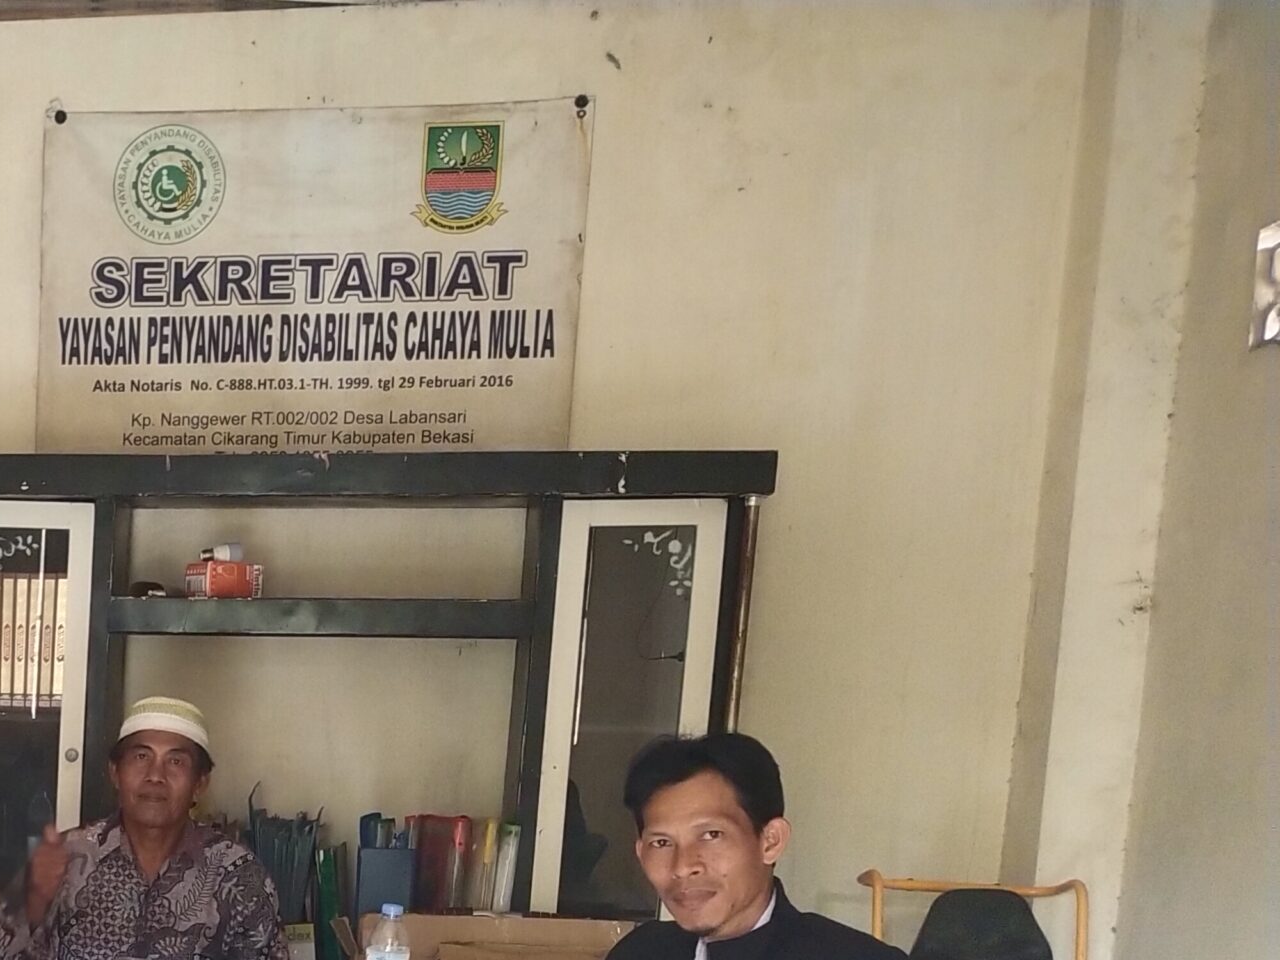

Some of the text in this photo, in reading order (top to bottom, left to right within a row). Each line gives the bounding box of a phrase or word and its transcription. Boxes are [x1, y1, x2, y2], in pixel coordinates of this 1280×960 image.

[117, 128, 222, 207] YAYASAN PENYANDANG DISABILITAS
[128, 212, 210, 240] CAHAYA MULIA
[89, 249, 528, 308] SEKRETARIAT
[58, 308, 555, 366] YAYASAN PENYANDANG DISABILITAS CAHAYA MULIA
[92, 374, 514, 393] Akta Notaris No. C-888.HT.03.1-TH. 1999. tgl 29 Februari 2016
[131, 409, 467, 430] Kp. Nanggewer RT.002/002 Desa Labansari
[122, 429, 475, 449] Kecamatan Cikarang Timur Kabupaten Bekasi
